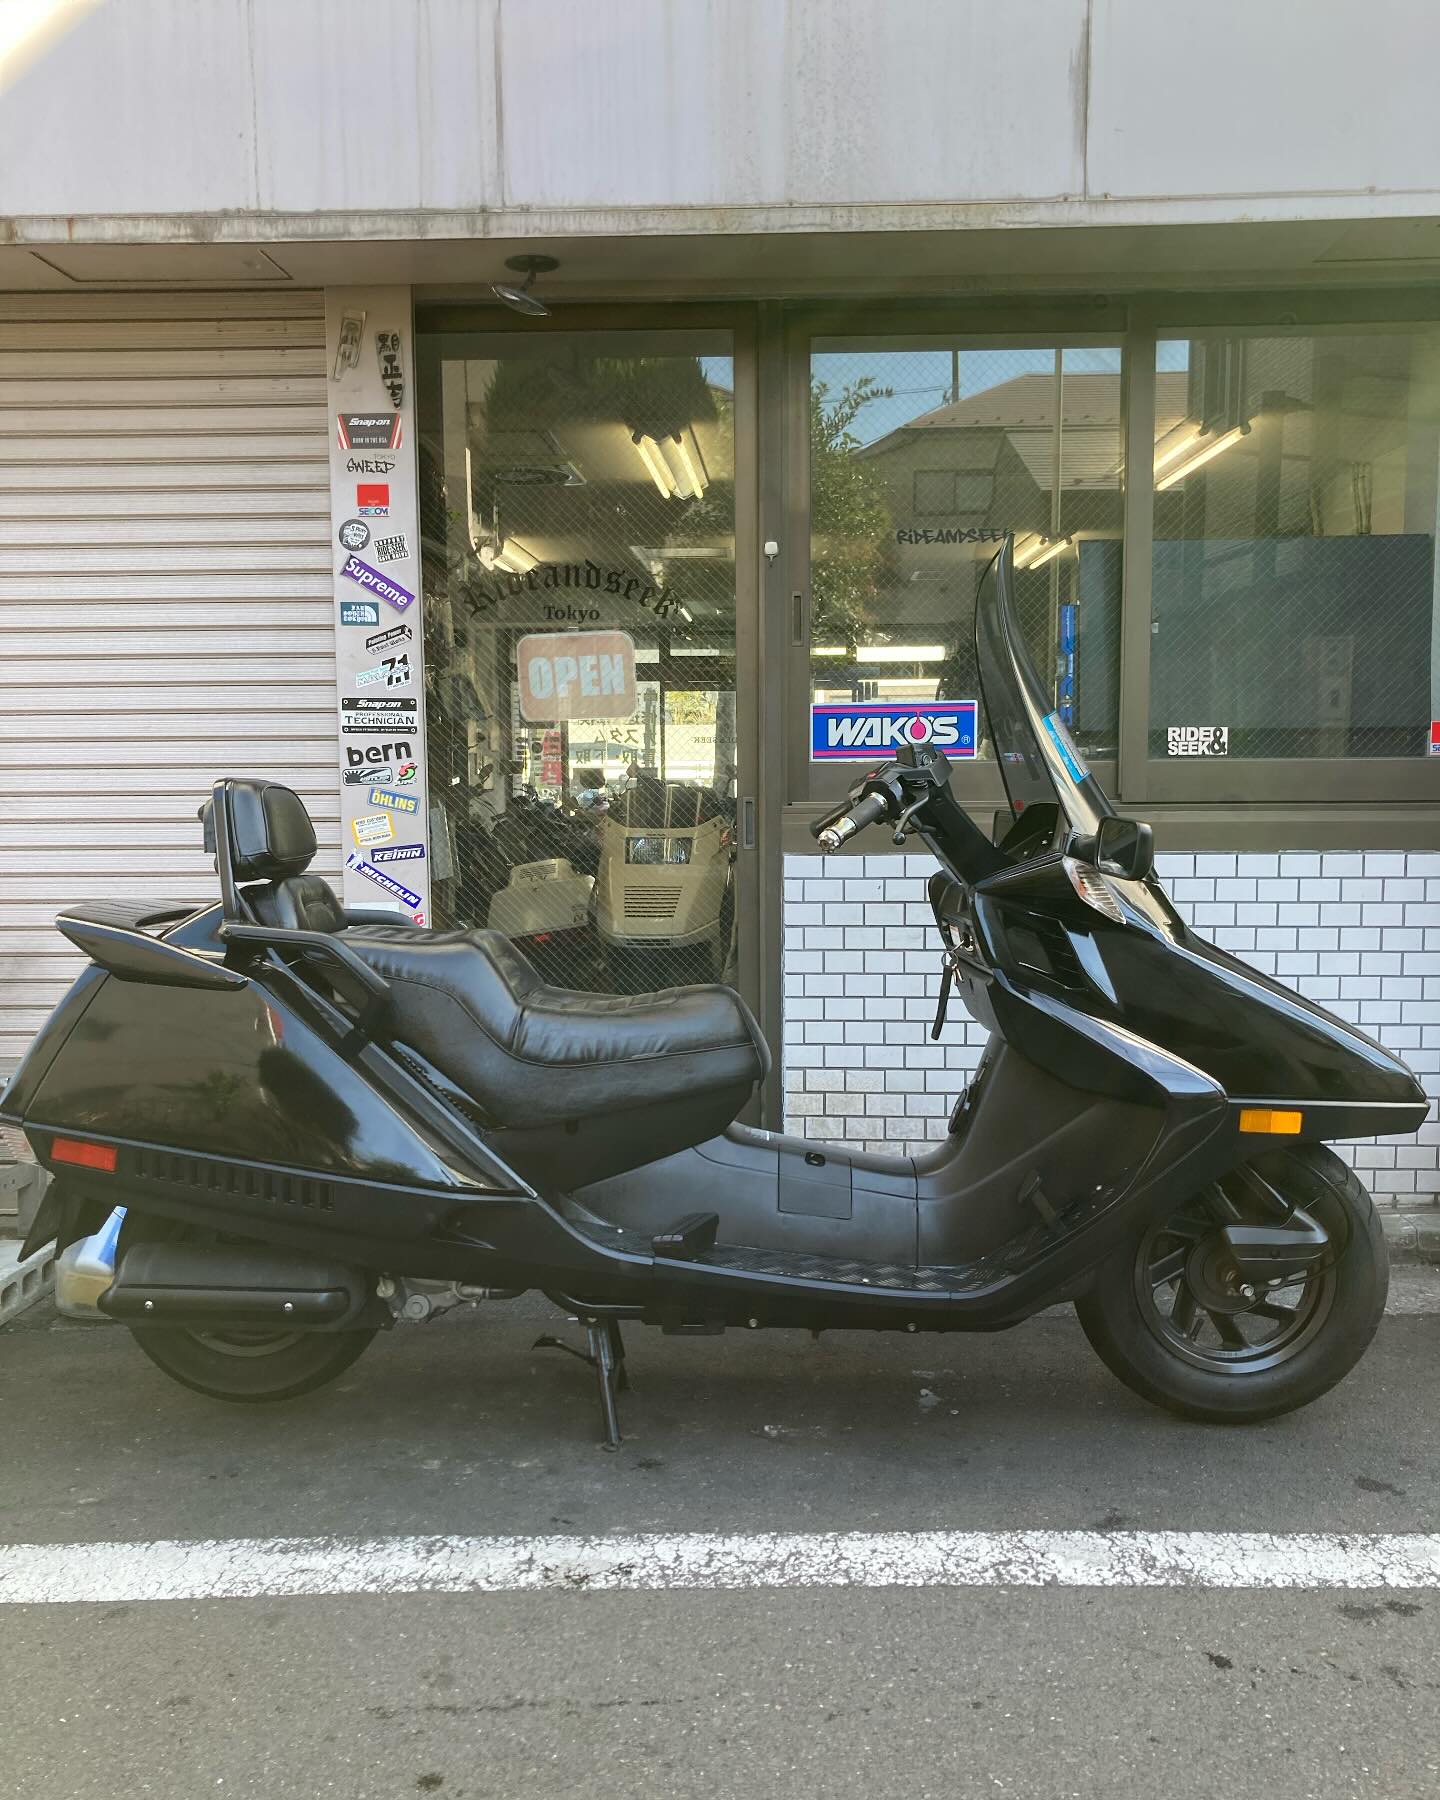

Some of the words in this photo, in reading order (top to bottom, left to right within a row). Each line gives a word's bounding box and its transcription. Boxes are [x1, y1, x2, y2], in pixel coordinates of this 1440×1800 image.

[348, 417, 391, 427] Snap-on
[346, 457, 396, 474] SWEEP
[358, 507, 389, 516] SECOM
[345, 558, 408, 606] Supreme
[544, 605, 600, 624] Tokyo
[527, 653, 626, 700] OPEN
[356, 699, 402, 709] Snap-on
[344, 715, 415, 725] TECHNICIAN
[827, 714, 960, 747] WAKO'S
[346, 741, 412, 767] bern
[1167, 741, 1211, 756] SEEK
[371, 788, 416, 812] ÖHLINS
[360, 865, 419, 904] MICHELIN
